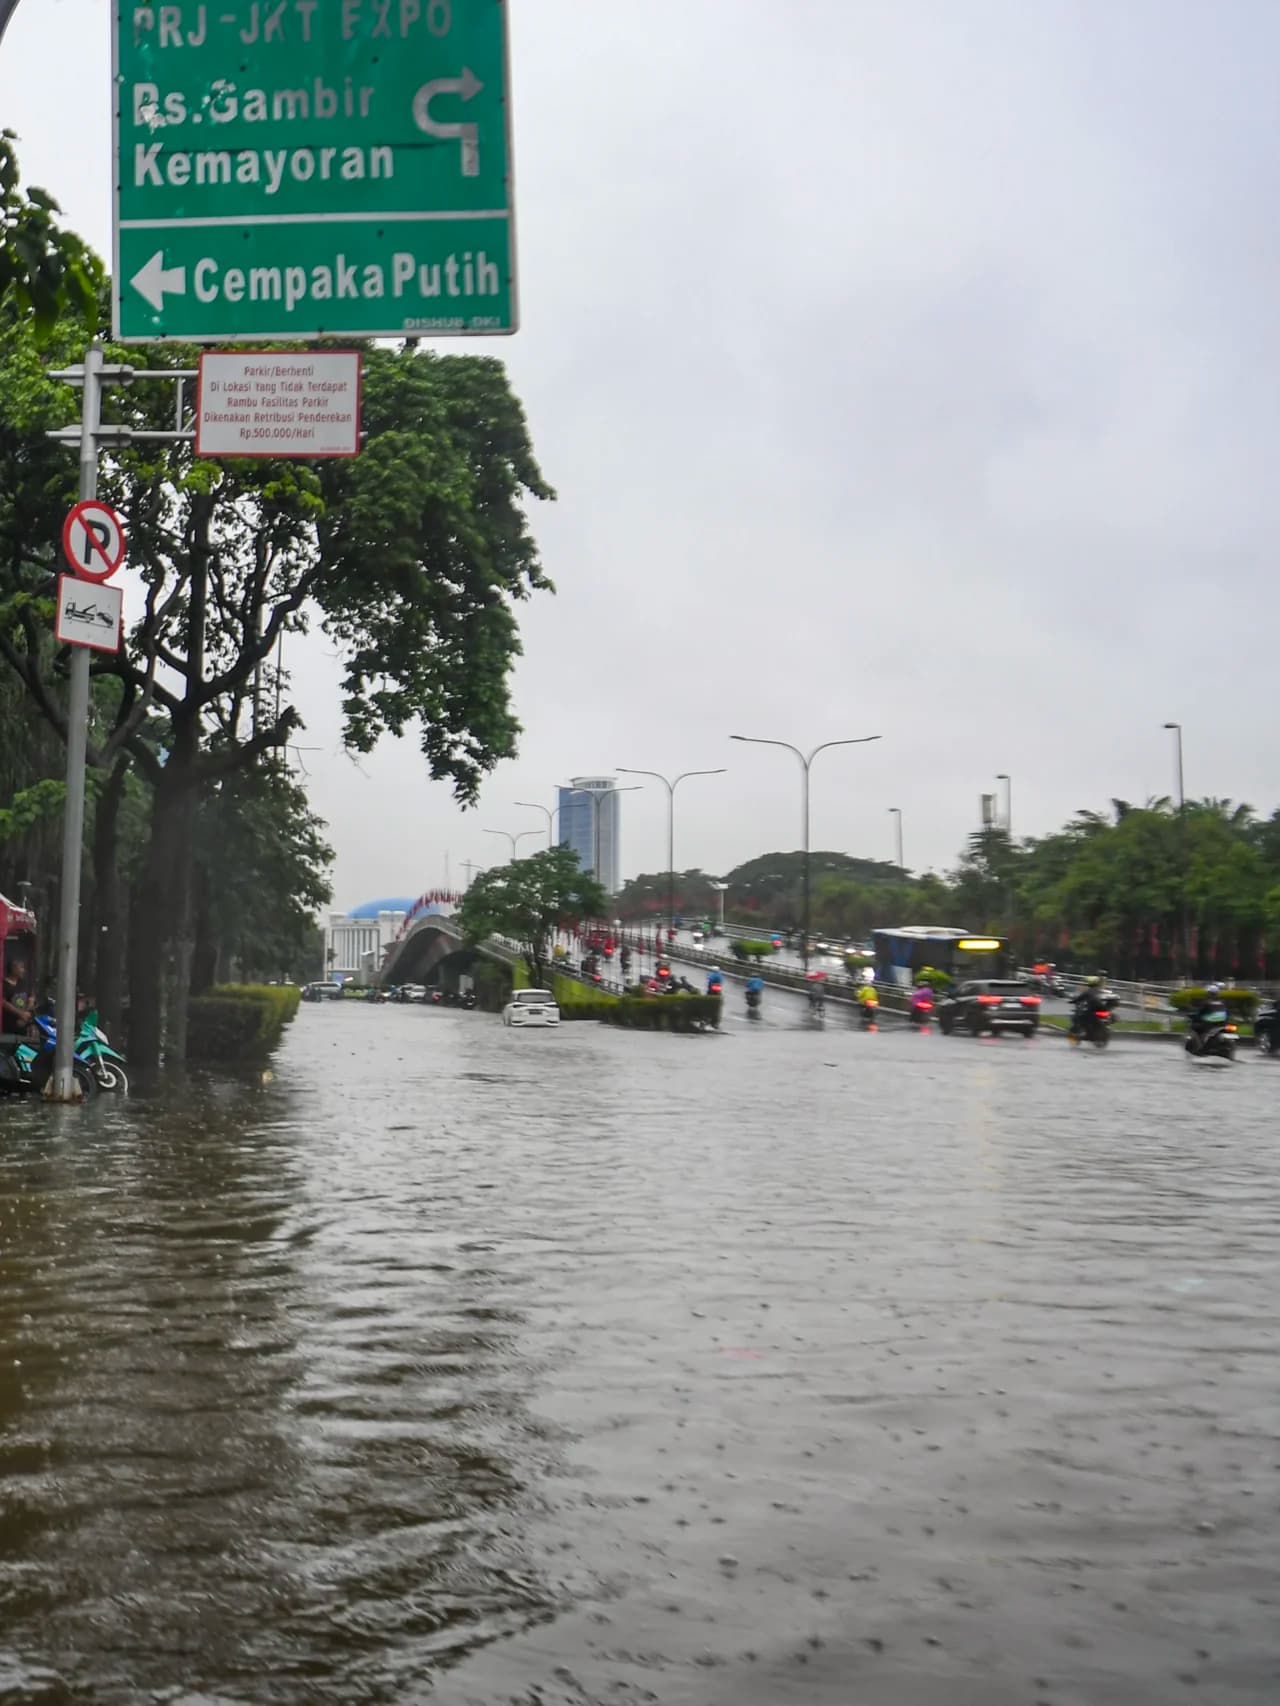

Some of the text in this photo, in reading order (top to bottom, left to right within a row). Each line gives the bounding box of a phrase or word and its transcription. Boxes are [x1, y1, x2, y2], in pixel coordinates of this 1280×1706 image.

[133, 5, 207, 48] PRJ
[134, 142, 394, 194] Kemayoran
[194, 251, 500, 311] Cempaka Putih
[244, 366, 315, 377] Parkir/Berhenti
[210, 382, 348, 395] Di Lokasi Yang Tidak Terdapat
[227, 397, 330, 408] Rambu Fasilitas Parkir
[204, 412, 352, 423] Dikenakan Retribusi Penderekan
